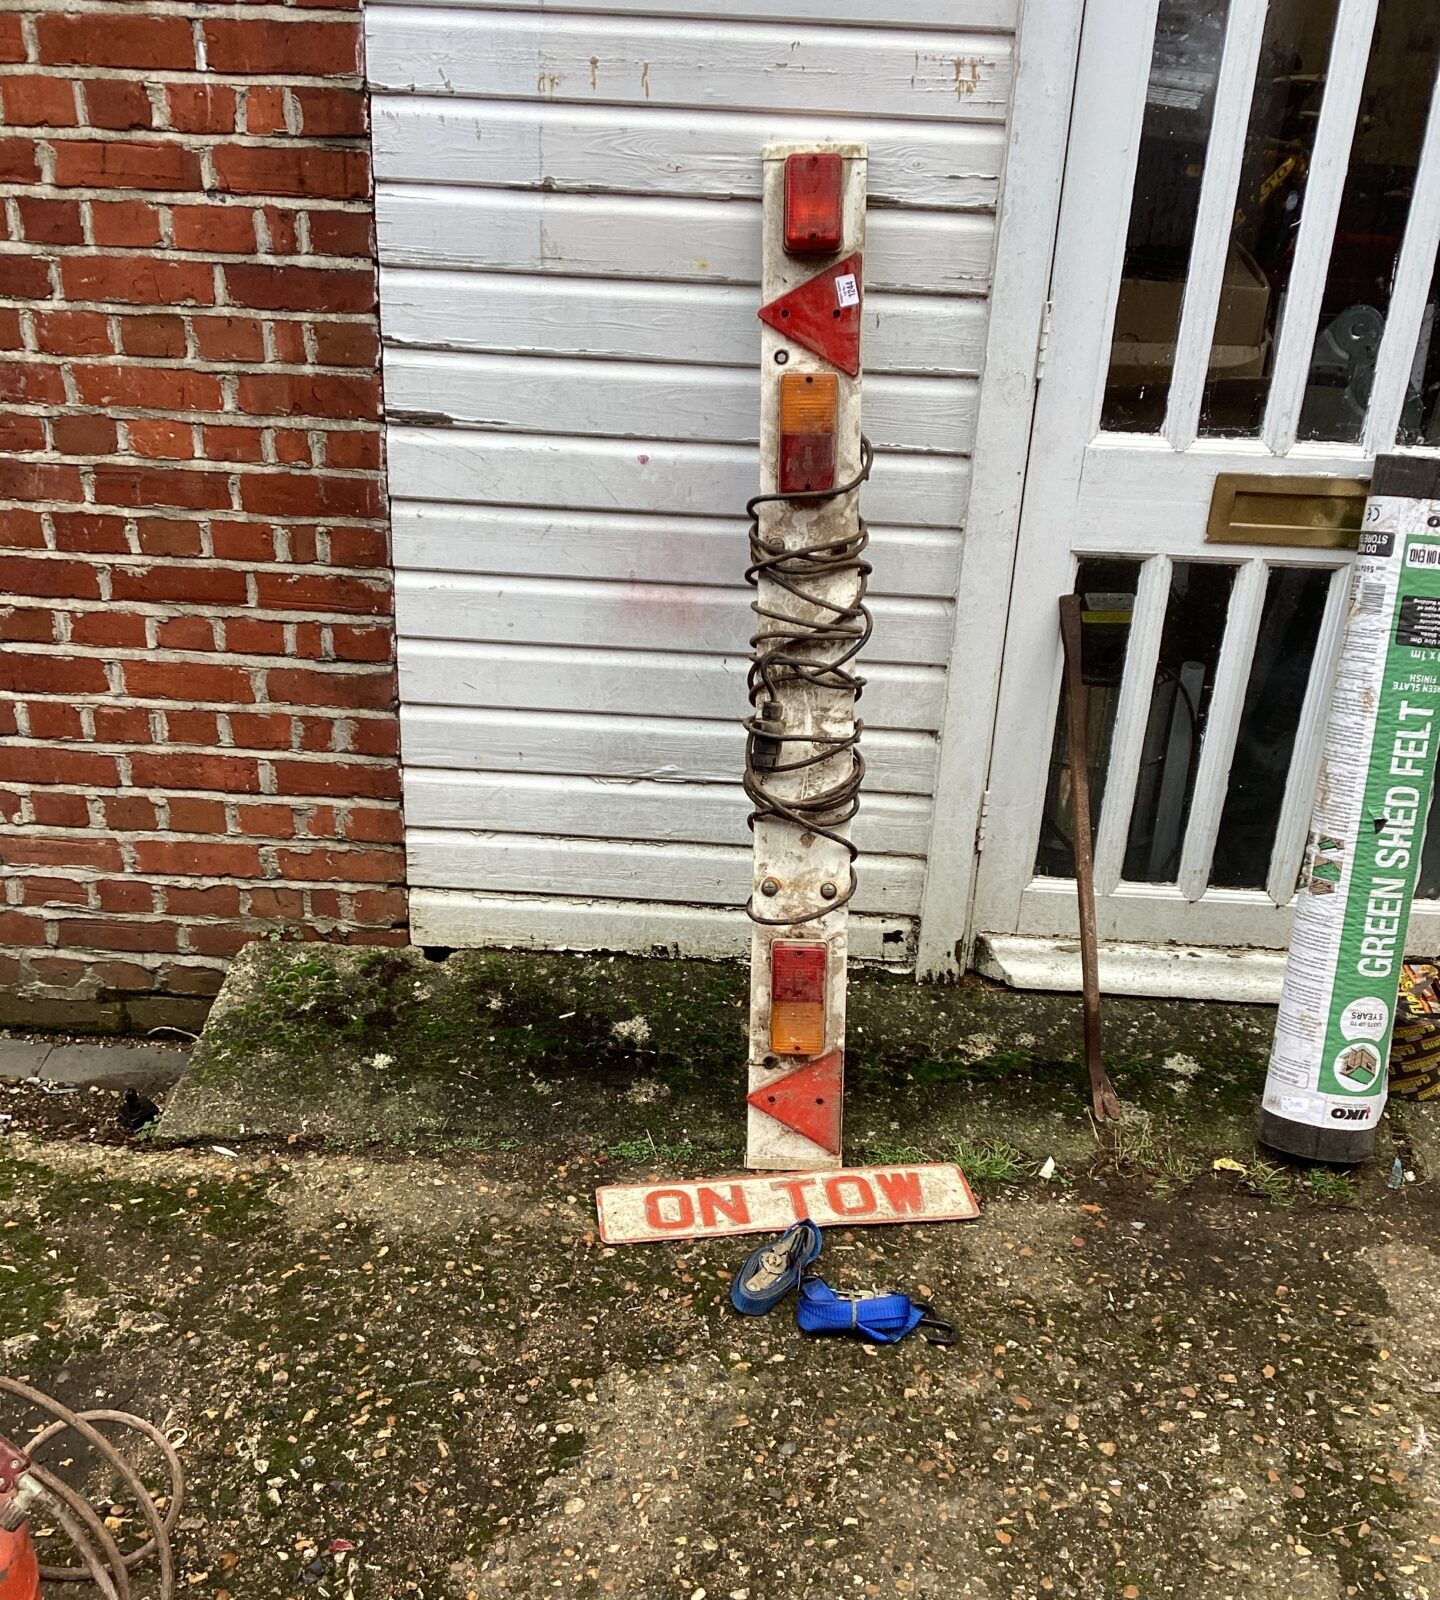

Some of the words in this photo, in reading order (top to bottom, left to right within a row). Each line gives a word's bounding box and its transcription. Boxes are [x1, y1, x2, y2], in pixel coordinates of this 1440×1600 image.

[845, 280, 856, 298] 1244
[1364, 533, 1388, 544] STORE
[1366, 543, 1377, 553] DO
[1409, 548, 1425, 562] END
[1410, 649, 1427, 661] 1m
[1409, 673, 1437, 683] FINISH
[1391, 680, 1421, 692] SLATE
[1390, 700, 1435, 777] FELT
[1375, 786, 1420, 870] SHED
[1357, 878, 1406, 979] GREEN
[1350, 1011, 1377, 1021] YEARS
[1378, 1012, 1383, 1020] 5
[645, 1184, 751, 1230] ON
[772, 1172, 922, 1218] TOW
